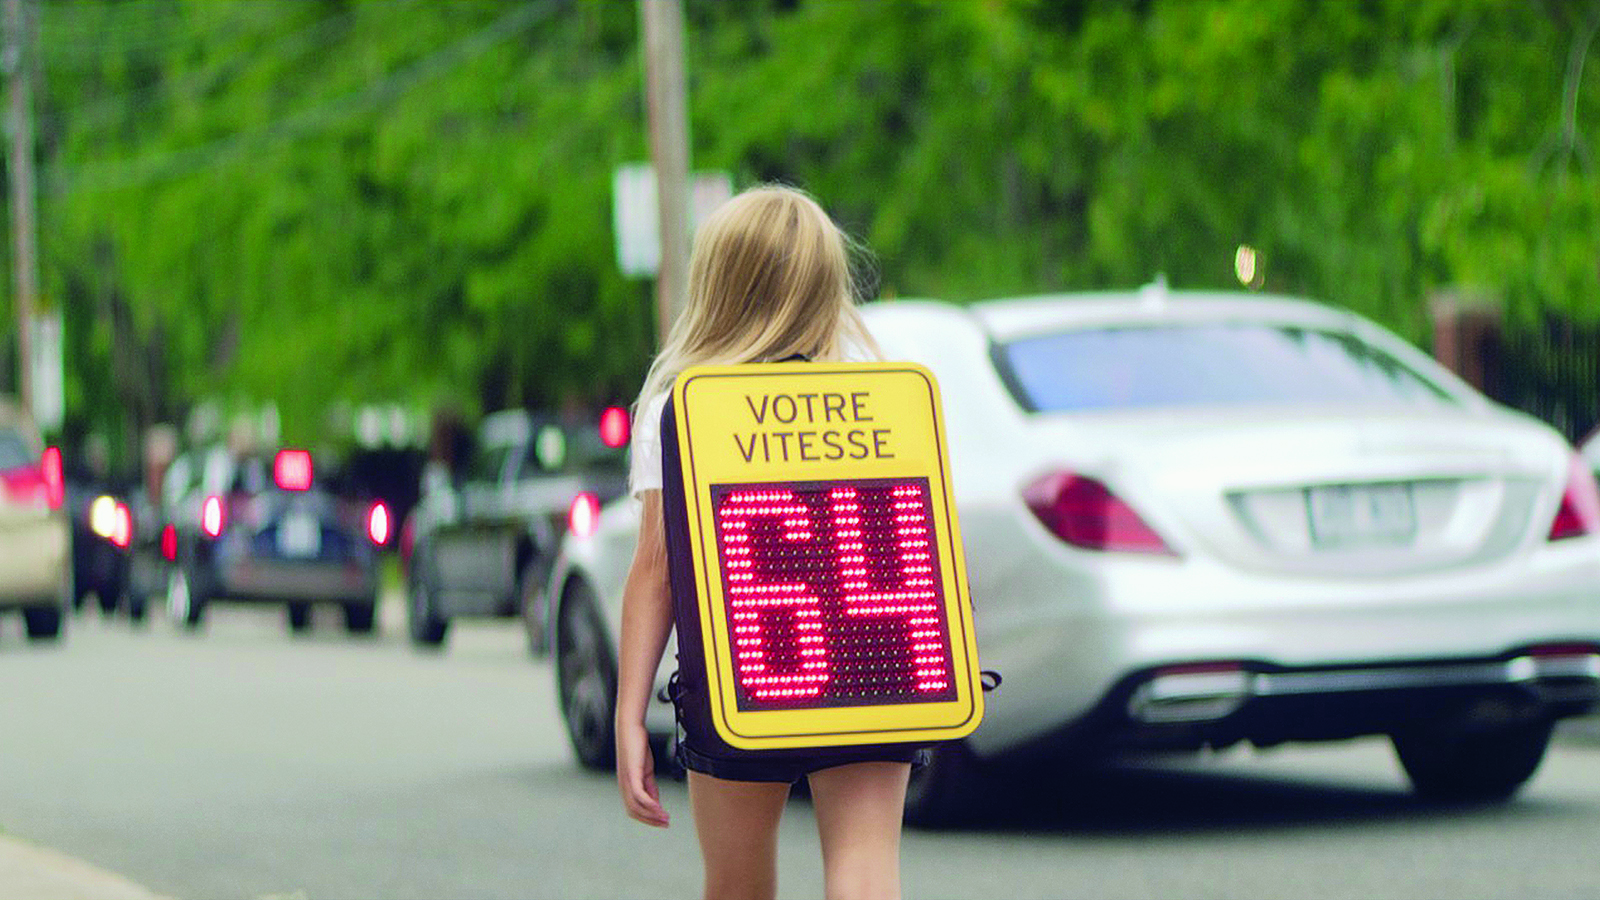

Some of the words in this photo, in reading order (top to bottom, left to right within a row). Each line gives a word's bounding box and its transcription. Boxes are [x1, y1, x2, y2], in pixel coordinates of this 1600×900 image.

[745, 392, 874, 424] VOTRE
[734, 429, 895, 463] VITESSE
[720, 485, 948, 699] 64
